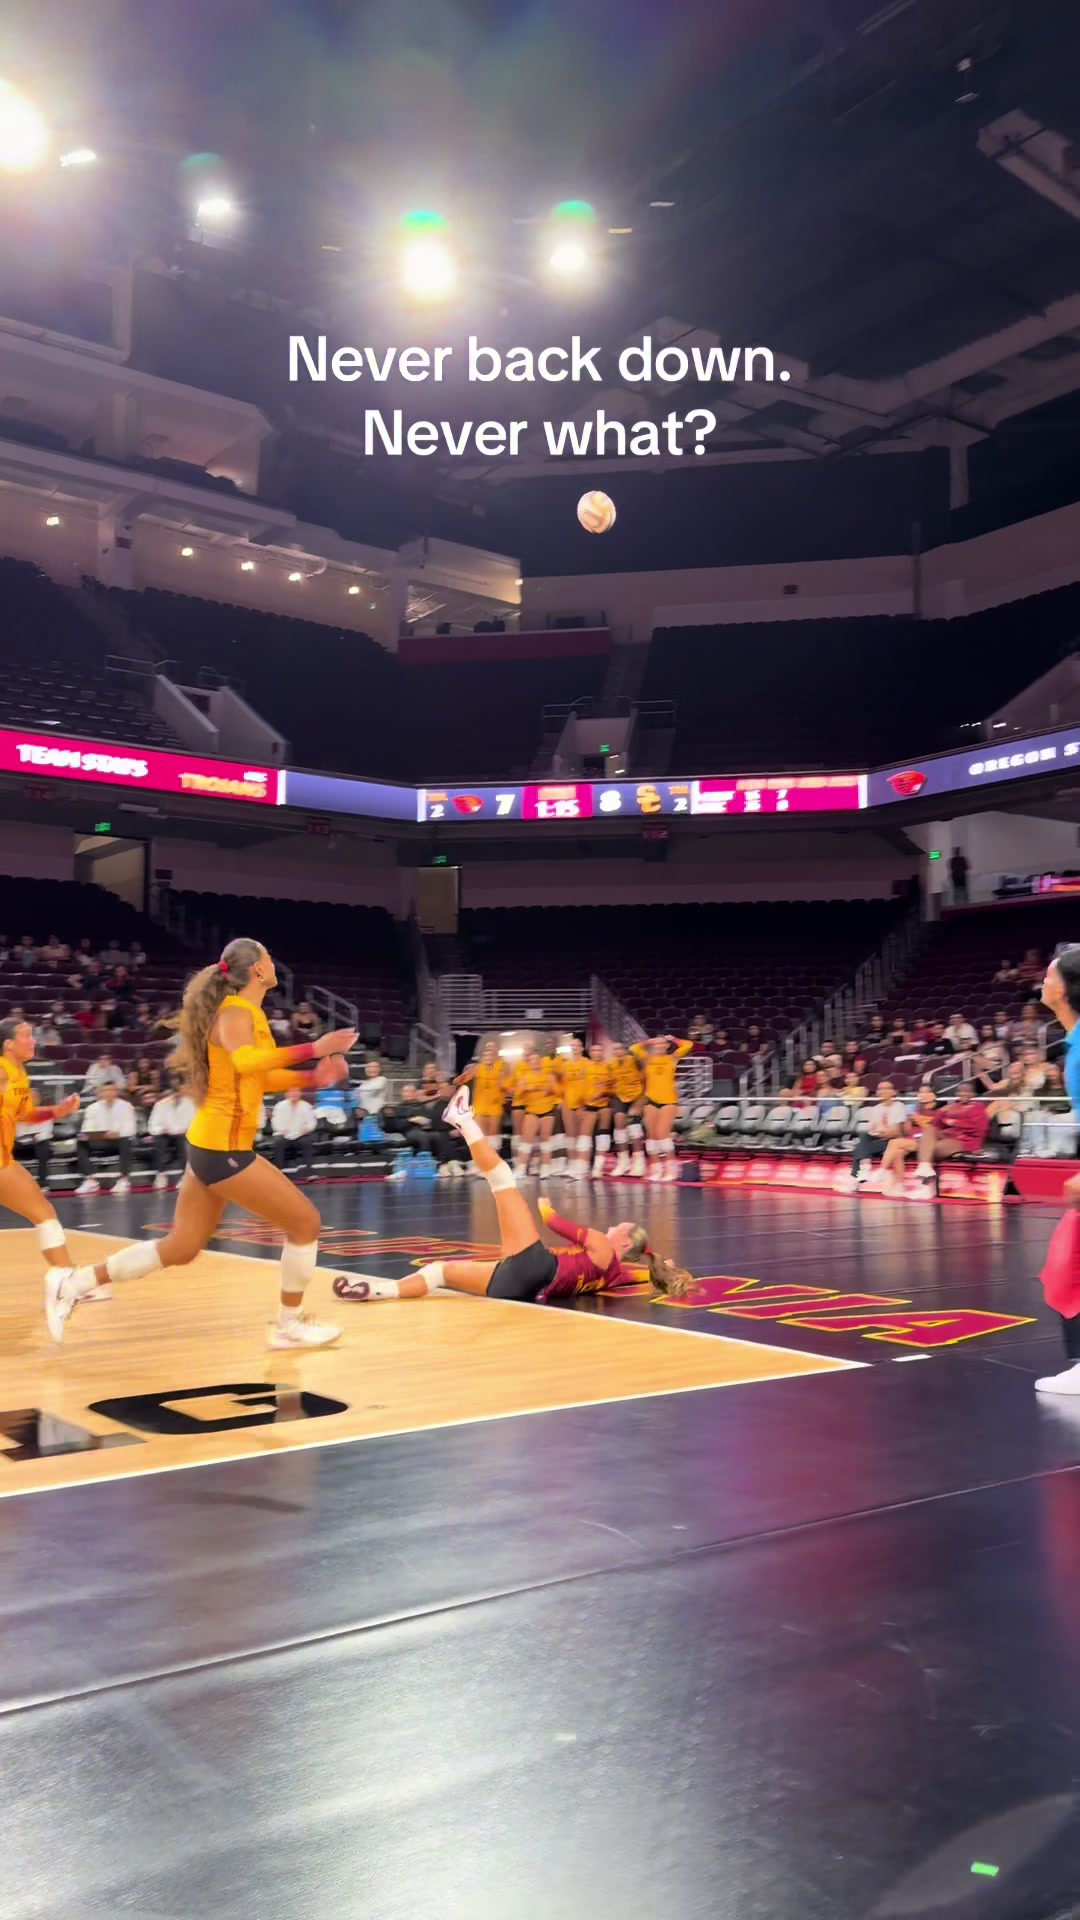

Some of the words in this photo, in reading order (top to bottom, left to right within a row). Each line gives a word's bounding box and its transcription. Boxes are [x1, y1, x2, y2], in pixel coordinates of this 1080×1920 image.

[16, 744, 80, 768] TEAM
[968, 747, 1057, 776] OREGON
[429, 804, 445, 818] 2
[495, 793, 516, 816] 7
[534, 799, 580, 818] 1:15
[599, 789, 622, 812] 8
[673, 797, 688, 812] 2
